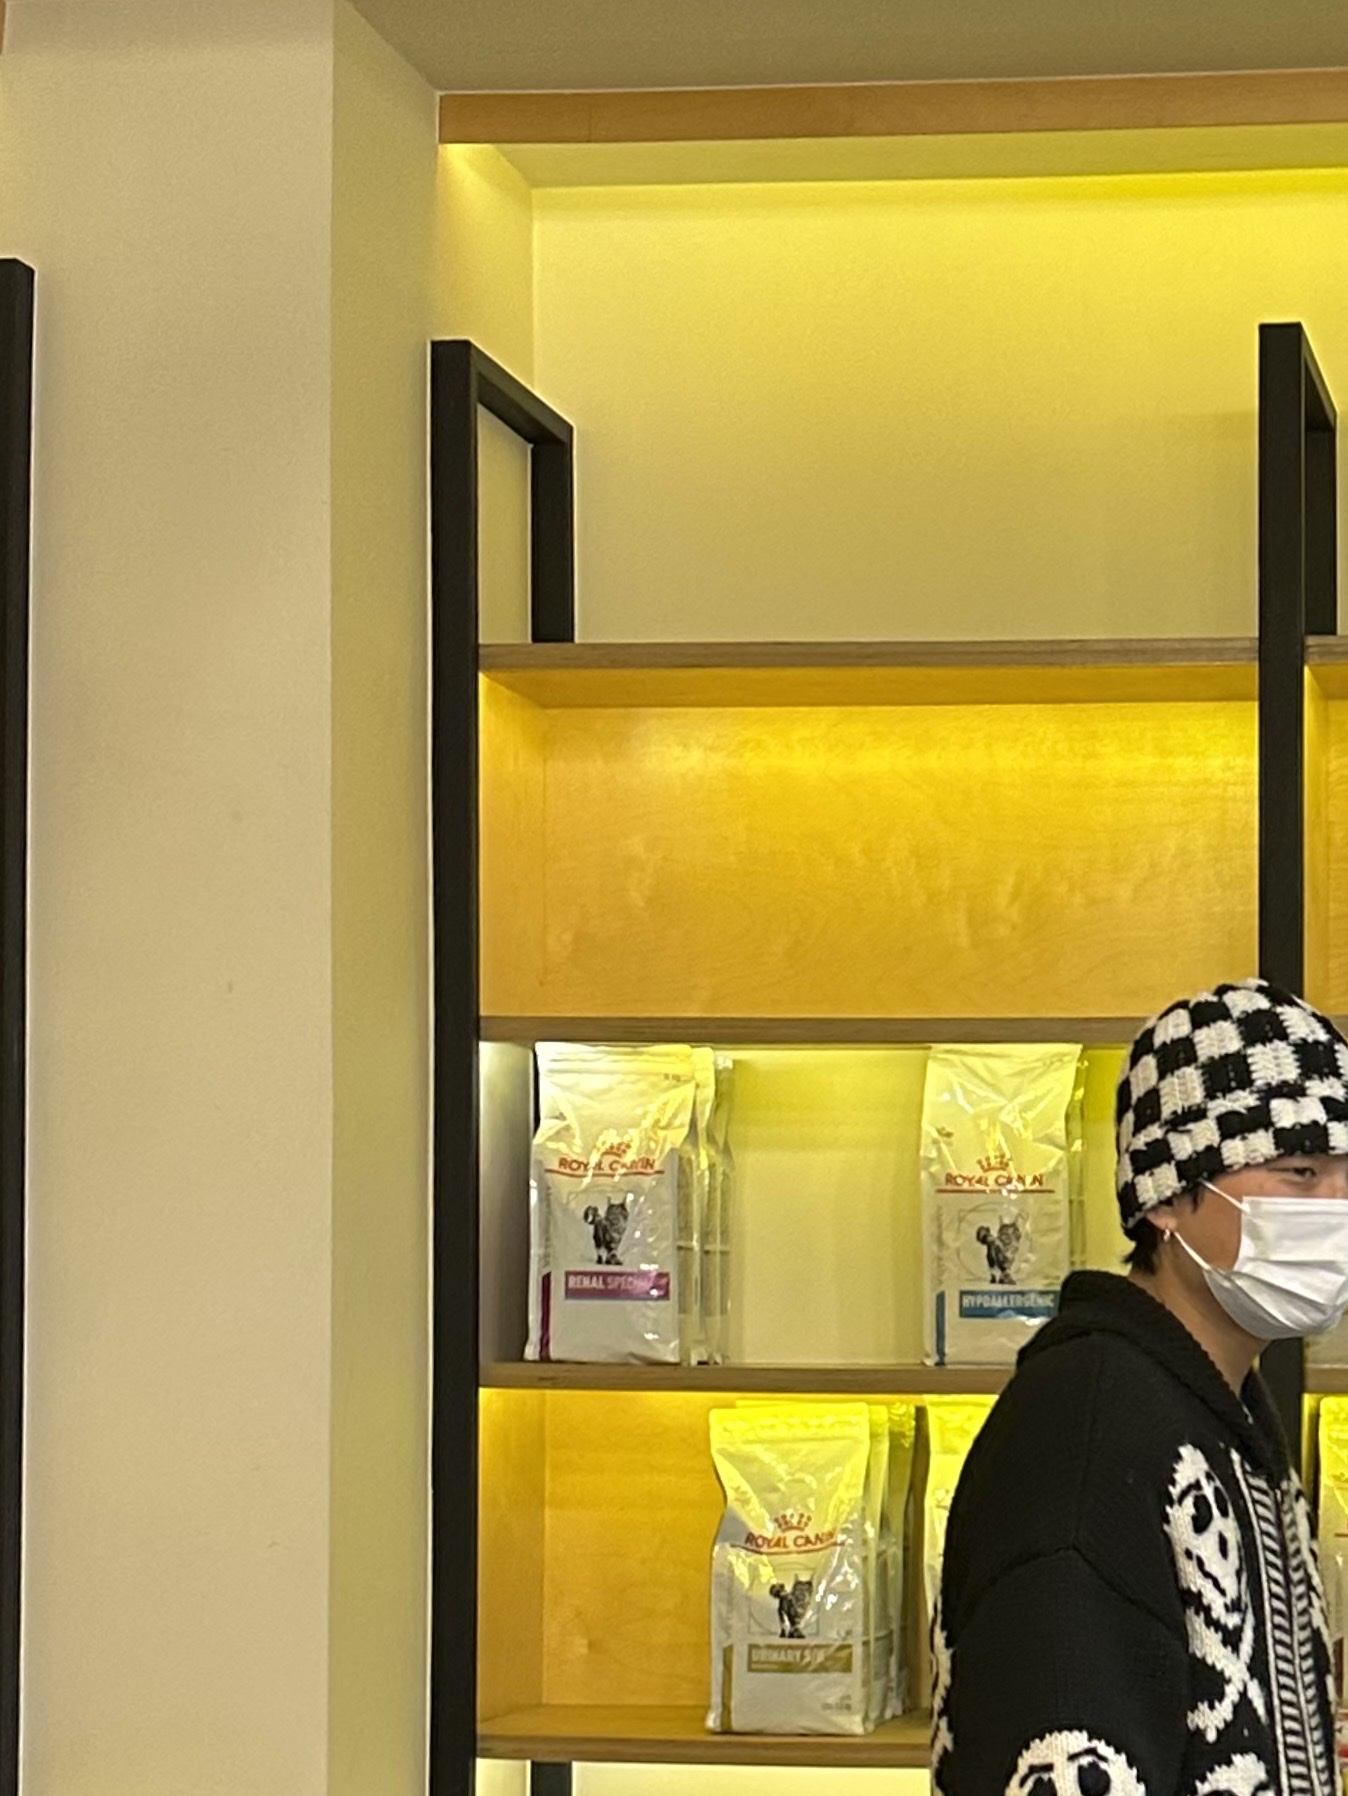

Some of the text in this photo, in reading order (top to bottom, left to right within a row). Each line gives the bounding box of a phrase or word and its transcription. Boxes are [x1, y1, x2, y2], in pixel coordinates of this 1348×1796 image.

[994, 1173, 1043, 1187] CANN
[568, 1275, 605, 1289] RENAL
[744, 1532, 789, 1549] ROYAL
